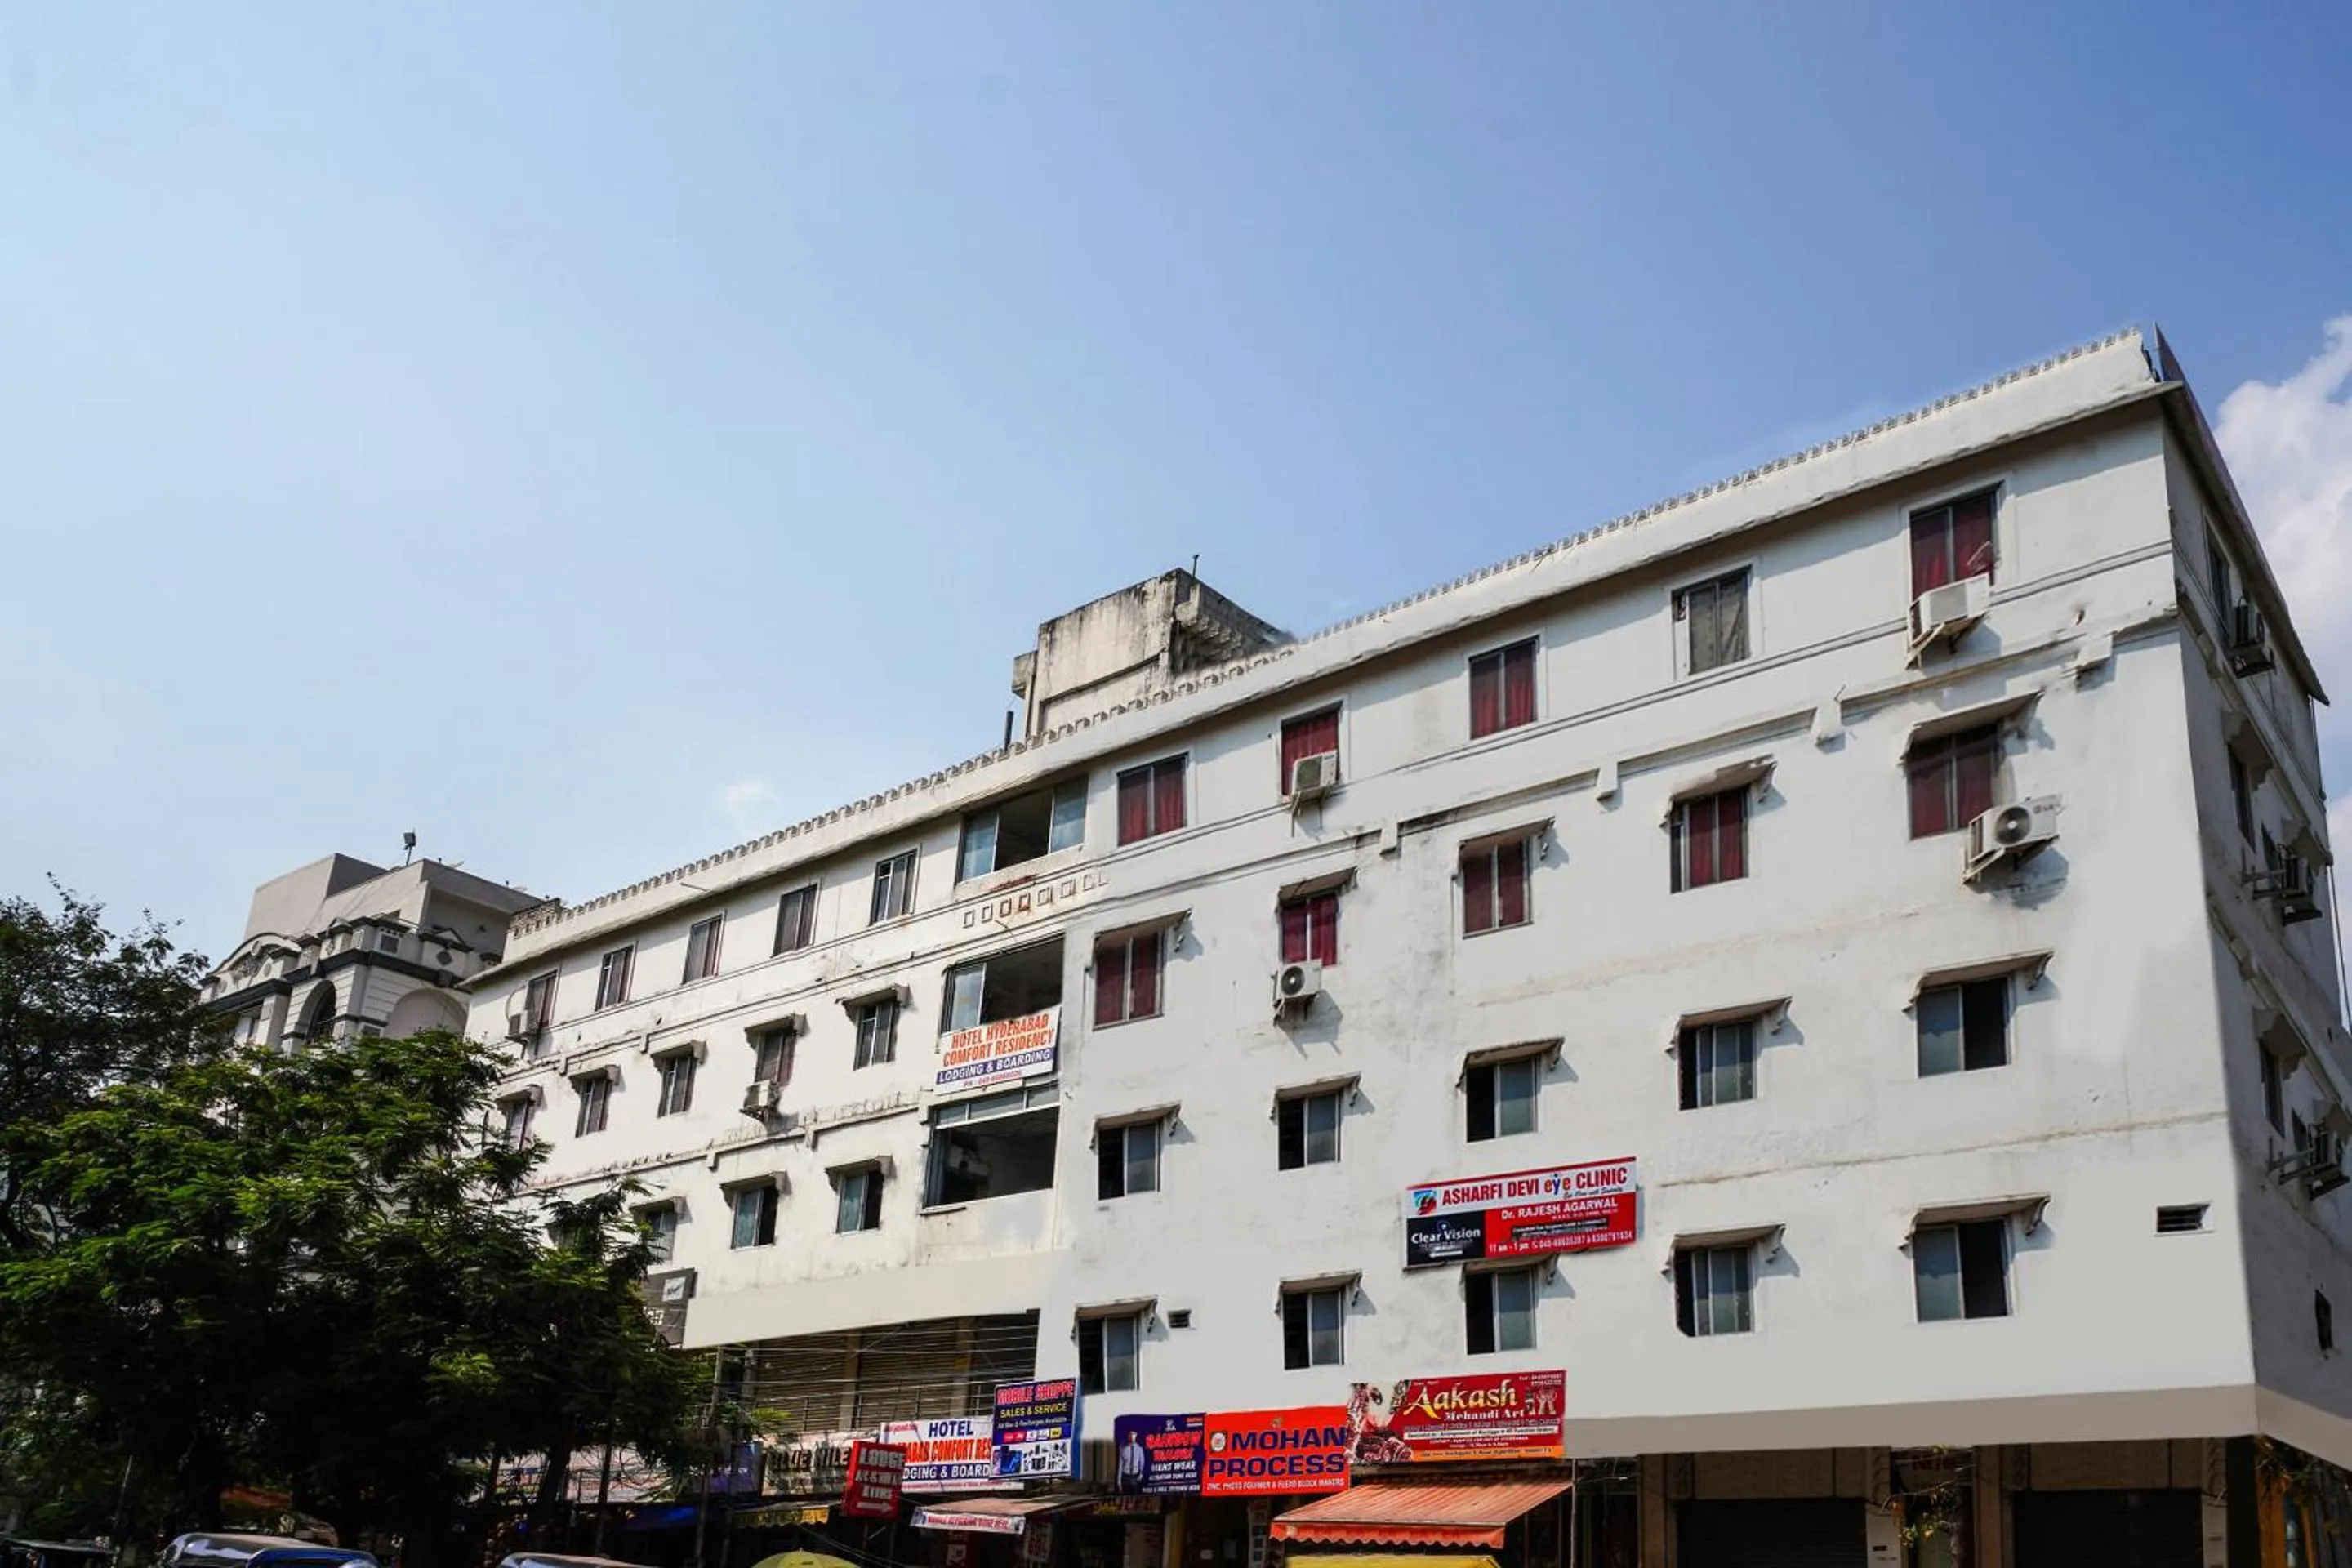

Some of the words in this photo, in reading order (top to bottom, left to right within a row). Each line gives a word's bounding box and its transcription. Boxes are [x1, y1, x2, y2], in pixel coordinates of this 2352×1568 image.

[951, 1027, 982, 1049] HOTEL
[986, 1013, 1049, 1041] HYDERABAD
[943, 1042, 993, 1067] COMFORT
[995, 1028, 1055, 1055] RESIDENCY
[939, 1065, 983, 1082] LODGING
[986, 1062, 994, 1071] &
[996, 1049, 1051, 1069] BOARDING
[1442, 1183, 1502, 1205] ASHARFI
[1508, 1178, 1539, 1197] DEVI
[1544, 1174, 1570, 1196] eye
[1575, 1167, 1628, 1189] CLINIC
[1501, 1210, 1515, 1219] Dr.
[1518, 1205, 1561, 1217] RAJESH
[1564, 1197, 1618, 1213] AGARWAL
[1411, 1232, 1441, 1244] Clear
[1443, 1227, 1481, 1240] Vision
[997, 1386, 1033, 1405] MOBILE
[1035, 1380, 1074, 1401] SHOPPE
[1403, 1379, 1518, 1419] Aakash
[1000, 1406, 1024, 1418] SALES
[1027, 1406, 1032, 1415] &
[1034, 1402, 1067, 1414] SERVICE
[1444, 1409, 1499, 1421] Mehandi
[1501, 1408, 1524, 1419] Art
[929, 1420, 973, 1437] HOTEL
[1231, 1427, 1347, 1450] MOHAN
[930, 1439, 974, 1462] COMFORT
[976, 1437, 992, 1460] RES
[902, 1467, 937, 1479] DGING
[940, 1467, 947, 1478] &
[951, 1464, 990, 1478] BOARD
[1208, 1453, 1345, 1478] PROCESS
